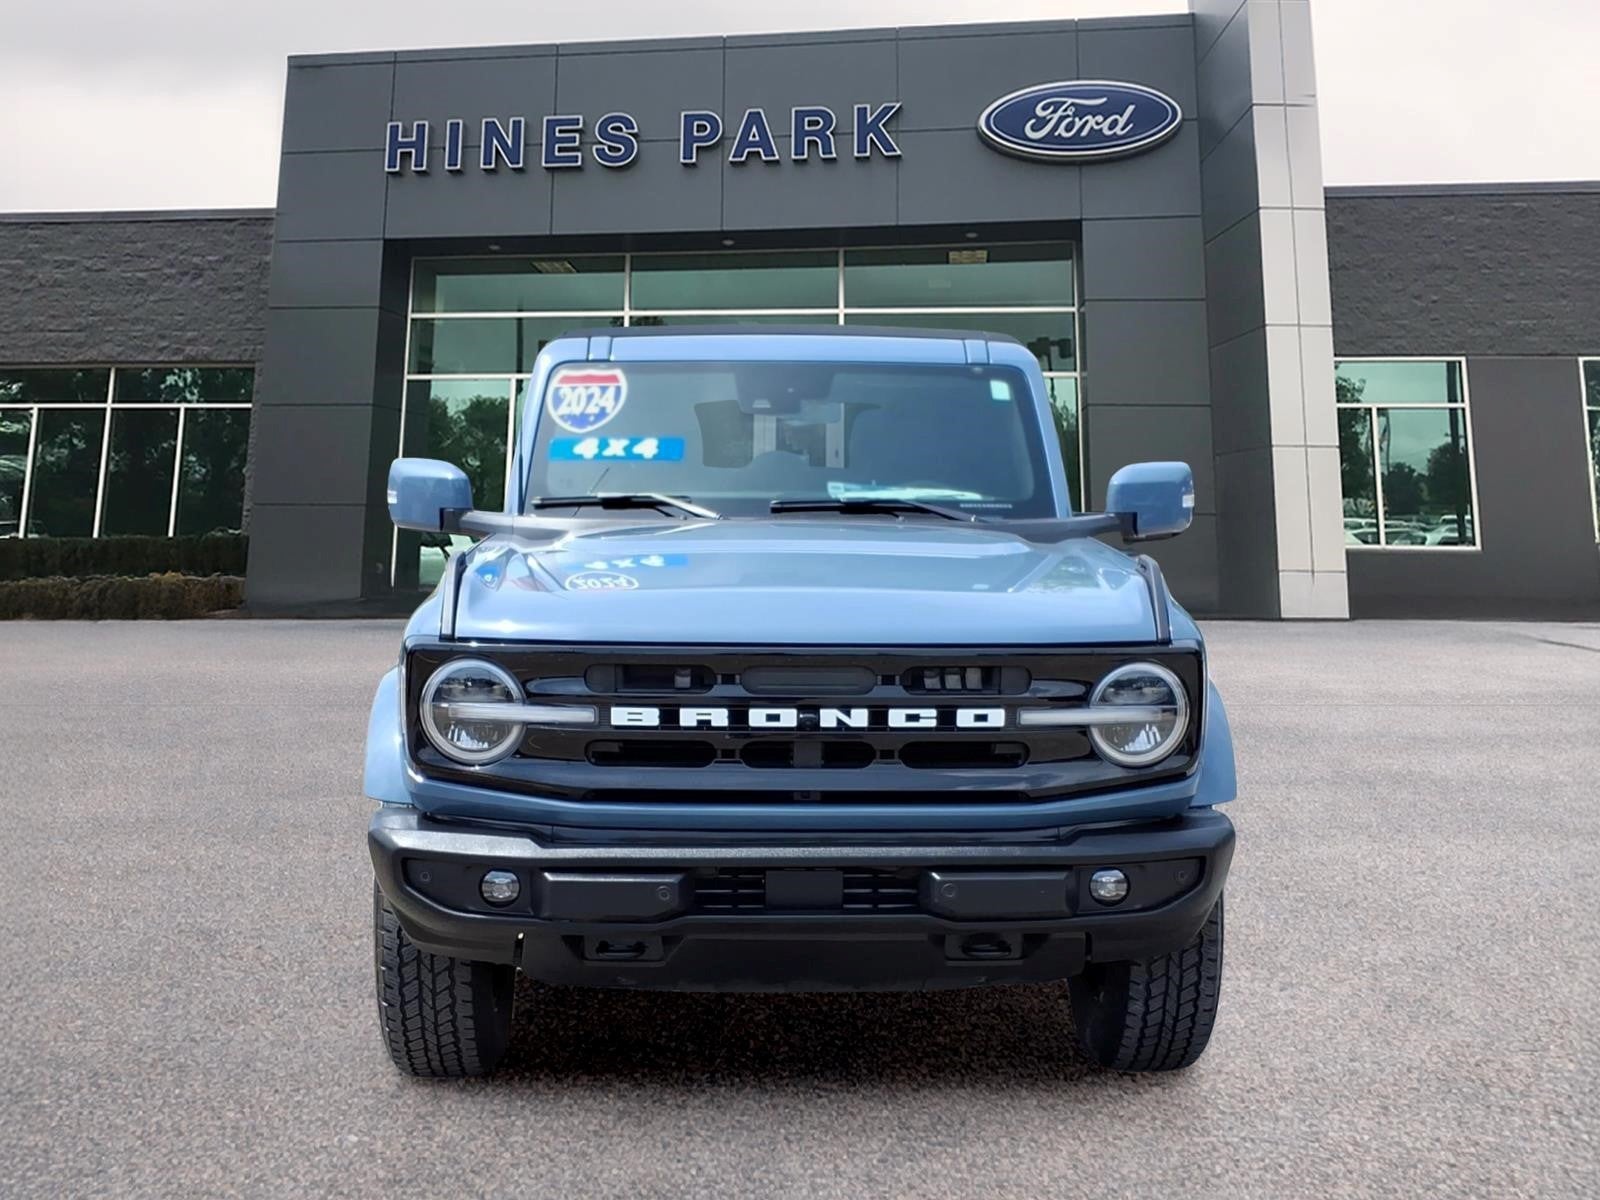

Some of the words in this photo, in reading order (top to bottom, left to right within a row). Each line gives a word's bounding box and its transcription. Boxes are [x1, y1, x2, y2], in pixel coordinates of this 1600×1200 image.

[1024, 97, 1136, 140] Ford
[385, 112, 639, 173] HINES
[680, 102, 903, 165] PARK
[556, 386, 616, 416] 2024
[610, 706, 1006, 729] BRONCO
